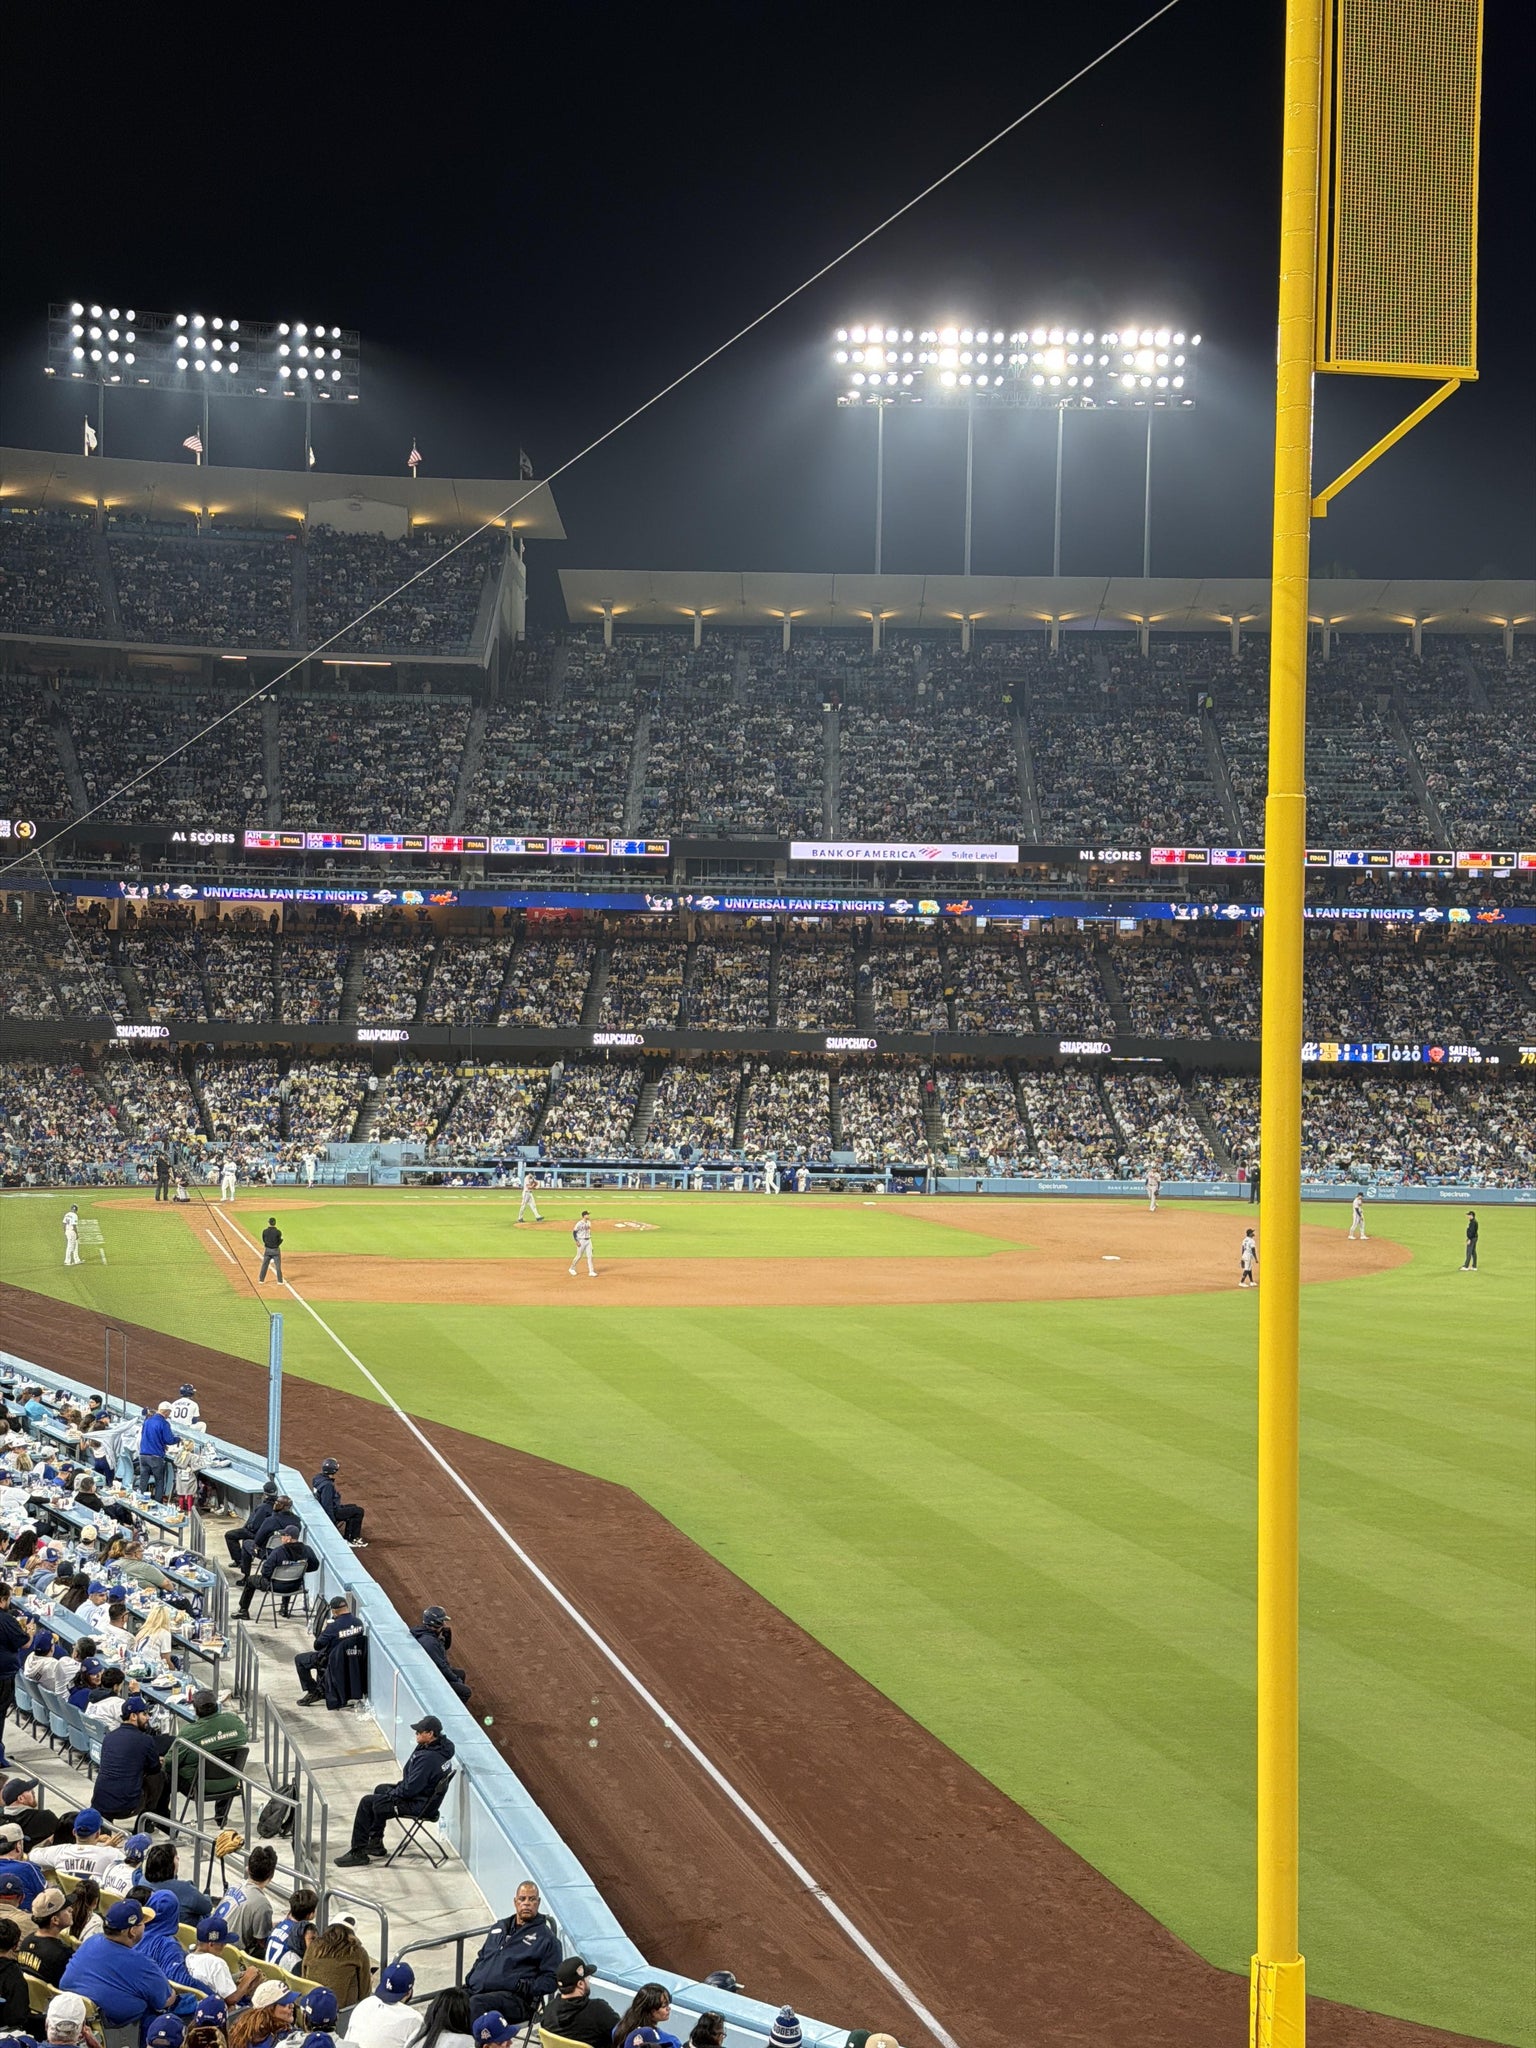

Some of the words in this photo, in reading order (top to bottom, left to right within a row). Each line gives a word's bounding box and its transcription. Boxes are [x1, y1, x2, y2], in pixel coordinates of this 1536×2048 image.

[172, 832, 186, 841] AL
[190, 832, 235, 843] SCORES
[405, 840, 422, 848] FINAL
[467, 841, 484, 849] FINAL
[812, 848, 844, 856] BANK
[846, 849, 861, 857] OF
[864, 850, 916, 858] AMERICA
[952, 850, 973, 860] Suite
[976, 851, 998, 860] Level
[1080, 850, 1095, 860] NL
[1098, 850, 1142, 861] SCORES
[1436, 856, 1444, 864] 9
[1500, 856, 1506, 865] 8
[203, 886, 268, 899] UNIVERSAL
[270, 888, 294, 900] FAN
[296, 889, 324, 900] FEST
[325, 890, 369, 902] NIGHTS
[725, 898, 788, 909] UNIVERSAL
[790, 899, 812, 910] FAN
[814, 899, 840, 910] FEST
[842, 900, 886, 911] NIGHTS
[1316, 908, 1340, 918] FAN
[1342, 908, 1368, 919] FEST
[1370, 908, 1414, 920] NIGHTS
[116, 1025, 161, 1038] SNAPCHAT
[358, 1029, 400, 1041] SNAPCHAT
[593, 1032, 636, 1045] SNAPCHAT
[826, 1037, 869, 1049] SNAPCHAT
[1060, 1041, 1103, 1054] SNAPCHAT
[1449, 1046, 1468, 1056] SALE
[1376, 1050, 1384, 1060] 6
[1038, 1182, 1067, 1191] Spectrum
[174, 1406, 188, 1418] 00
[64, 1858, 96, 1872] OHTANI
[104, 1876, 128, 1893] AYLOR
[266, 1939, 284, 1963] 17
[18, 1952, 42, 1971] OHTANI
